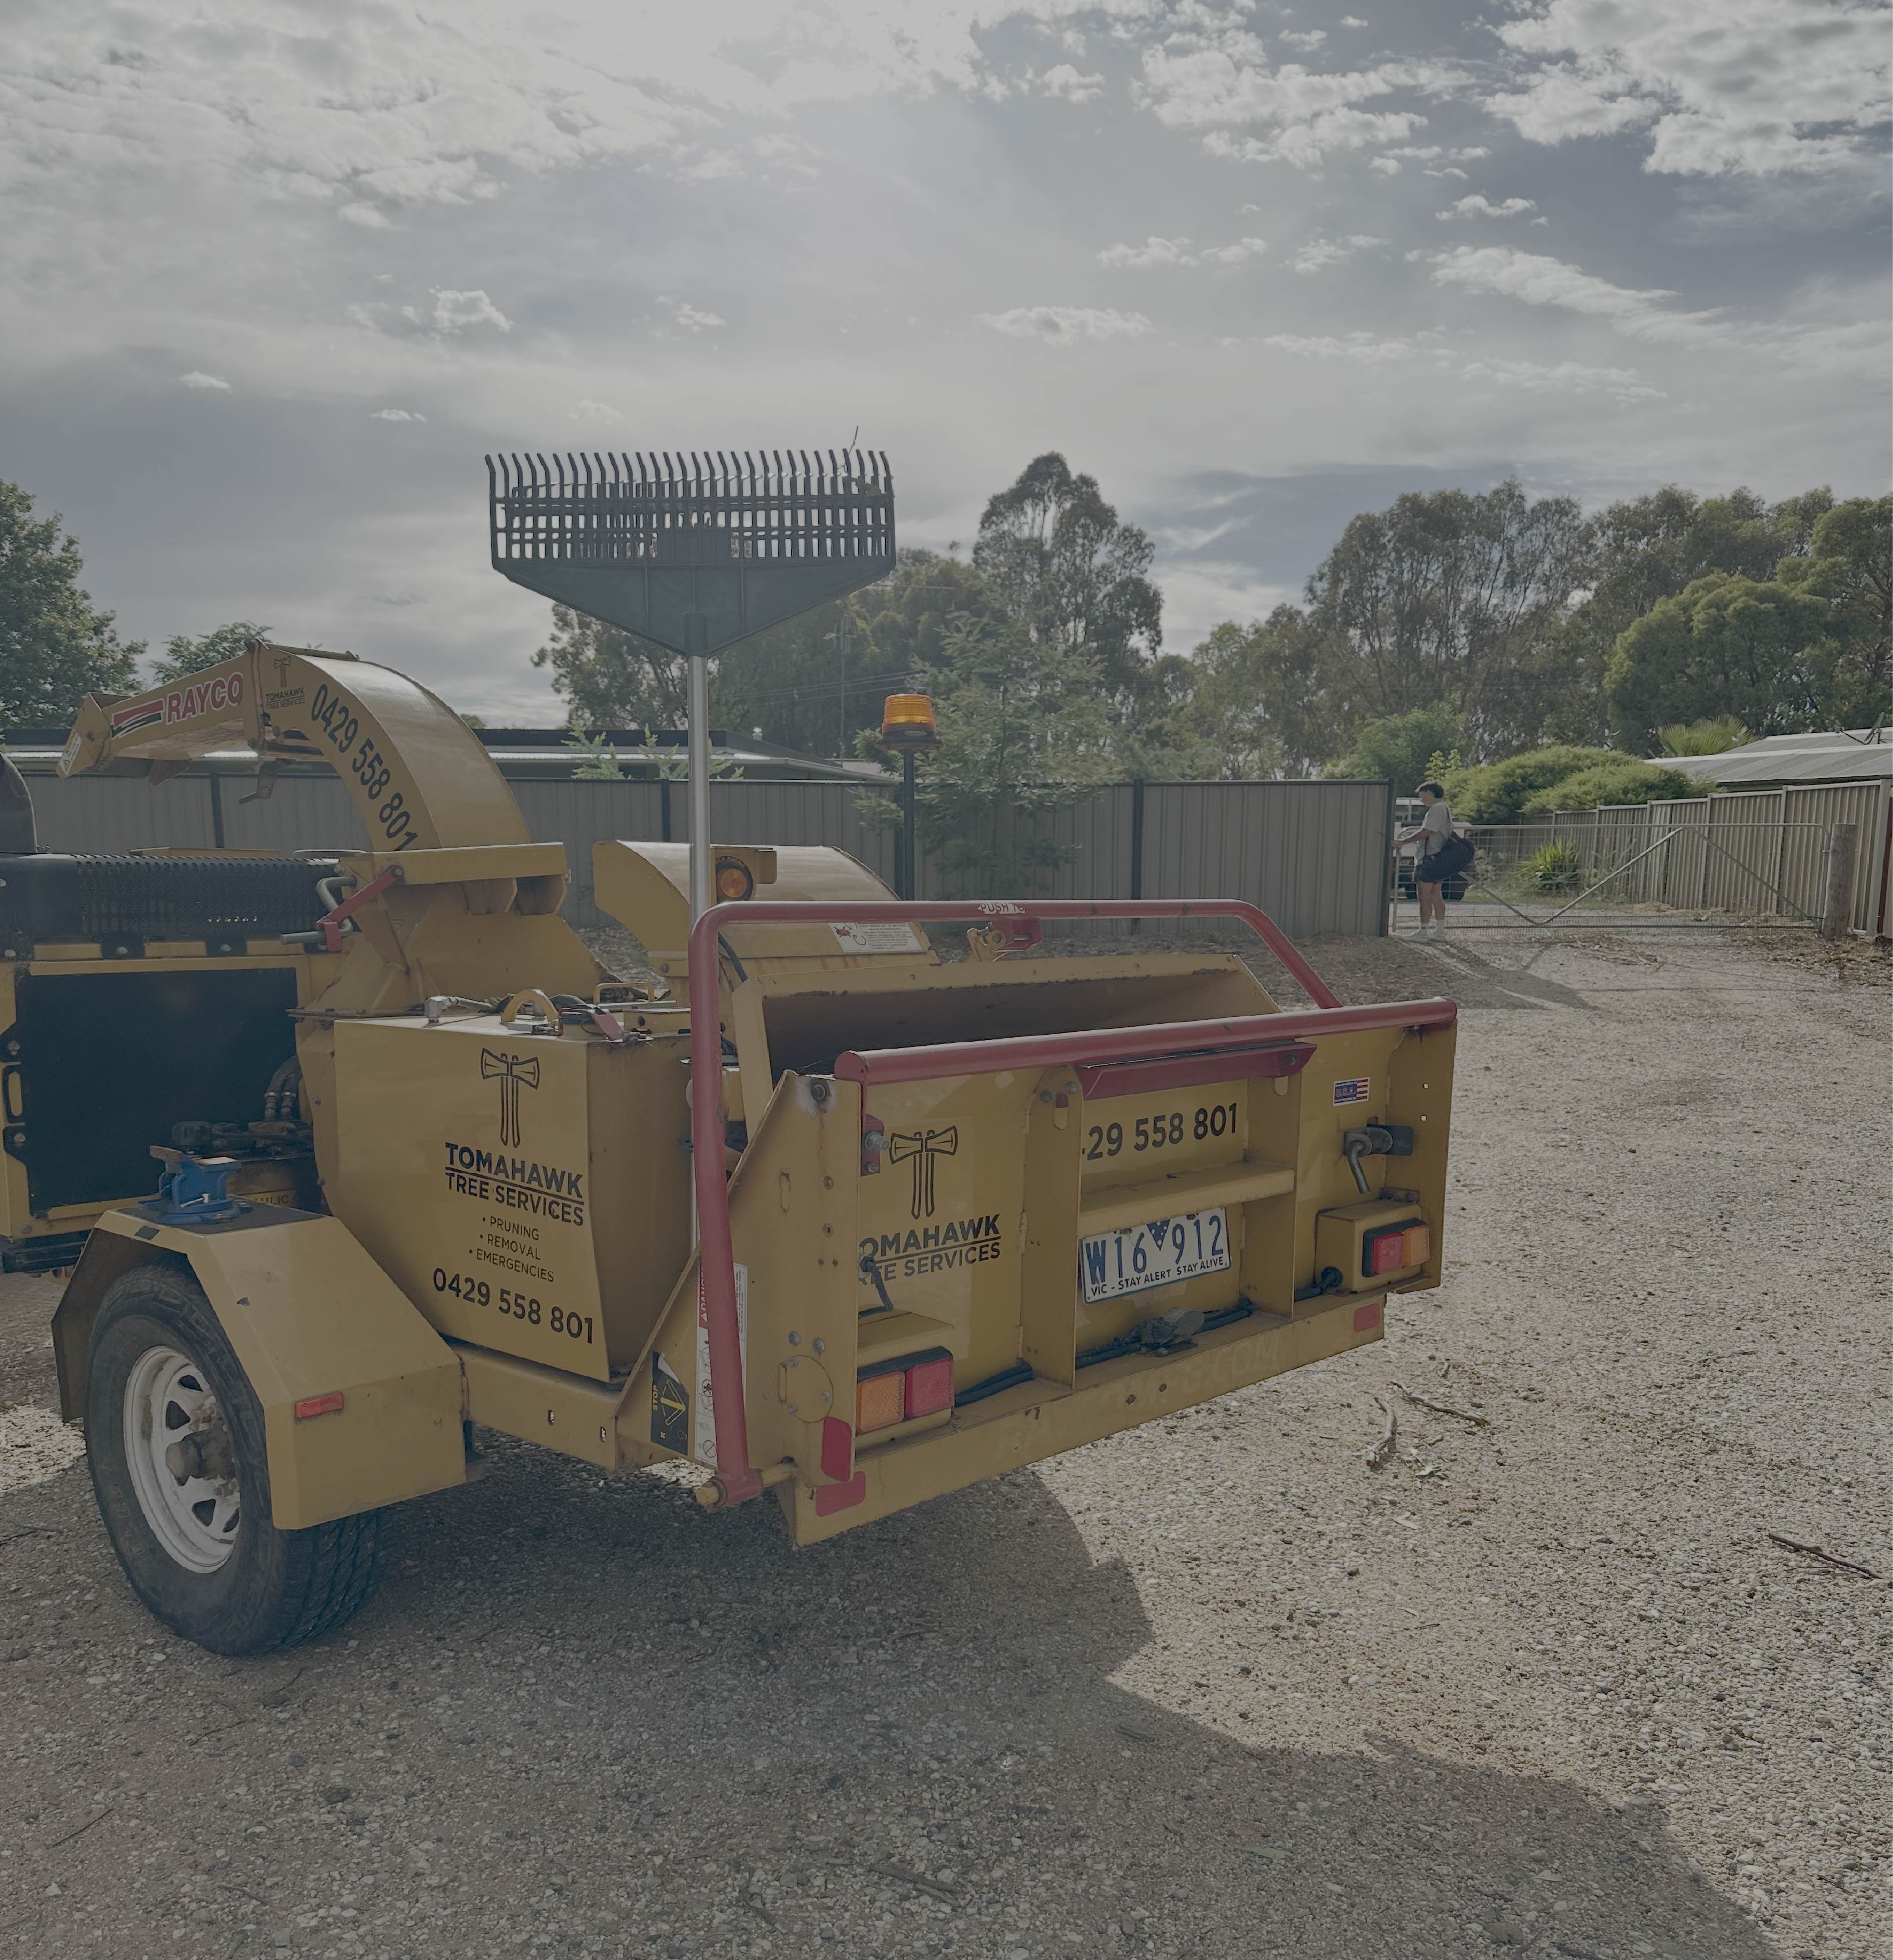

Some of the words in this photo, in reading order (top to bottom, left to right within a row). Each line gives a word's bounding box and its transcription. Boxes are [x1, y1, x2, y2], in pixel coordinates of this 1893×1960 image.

[166, 671, 243, 725] RAYCO
[265, 687, 305, 701] TOMAHAWK
[280, 698, 306, 707] SERVICES
[311, 684, 358, 753] 0429
[352, 738, 391, 800] 558
[379, 792, 418, 852] 801
[980, 903, 1009, 912] PUSH
[1082, 1122, 1123, 1160] 29
[1133, 1112, 1184, 1151] 558
[1193, 1103, 1237, 1140] 801
[445, 1142, 583, 1198] TOMAHAWK
[445, 1172, 489, 1200] TREE
[495, 1185, 583, 1227] SERVICES
[487, 1233, 541, 1260] REMOVAL
[491, 1216, 539, 1240] PRUNING
[859, 1214, 1000, 1257] OMAHAWK
[476, 1249, 554, 1282] EMERGENCIES
[904, 1242, 1000, 1277] SERVICES
[1091, 1284, 1108, 1296] VIC
[1118, 1276, 1141, 1290] STAY
[1144, 1269, 1171, 1284] ALERT
[1177, 1262, 1198, 1275] STAY
[1200, 1256, 1224, 1270] ALIVE
[433, 1268, 490, 1306] 0429
[499, 1288, 541, 1325] 558
[550, 1306, 593, 1344] 801
